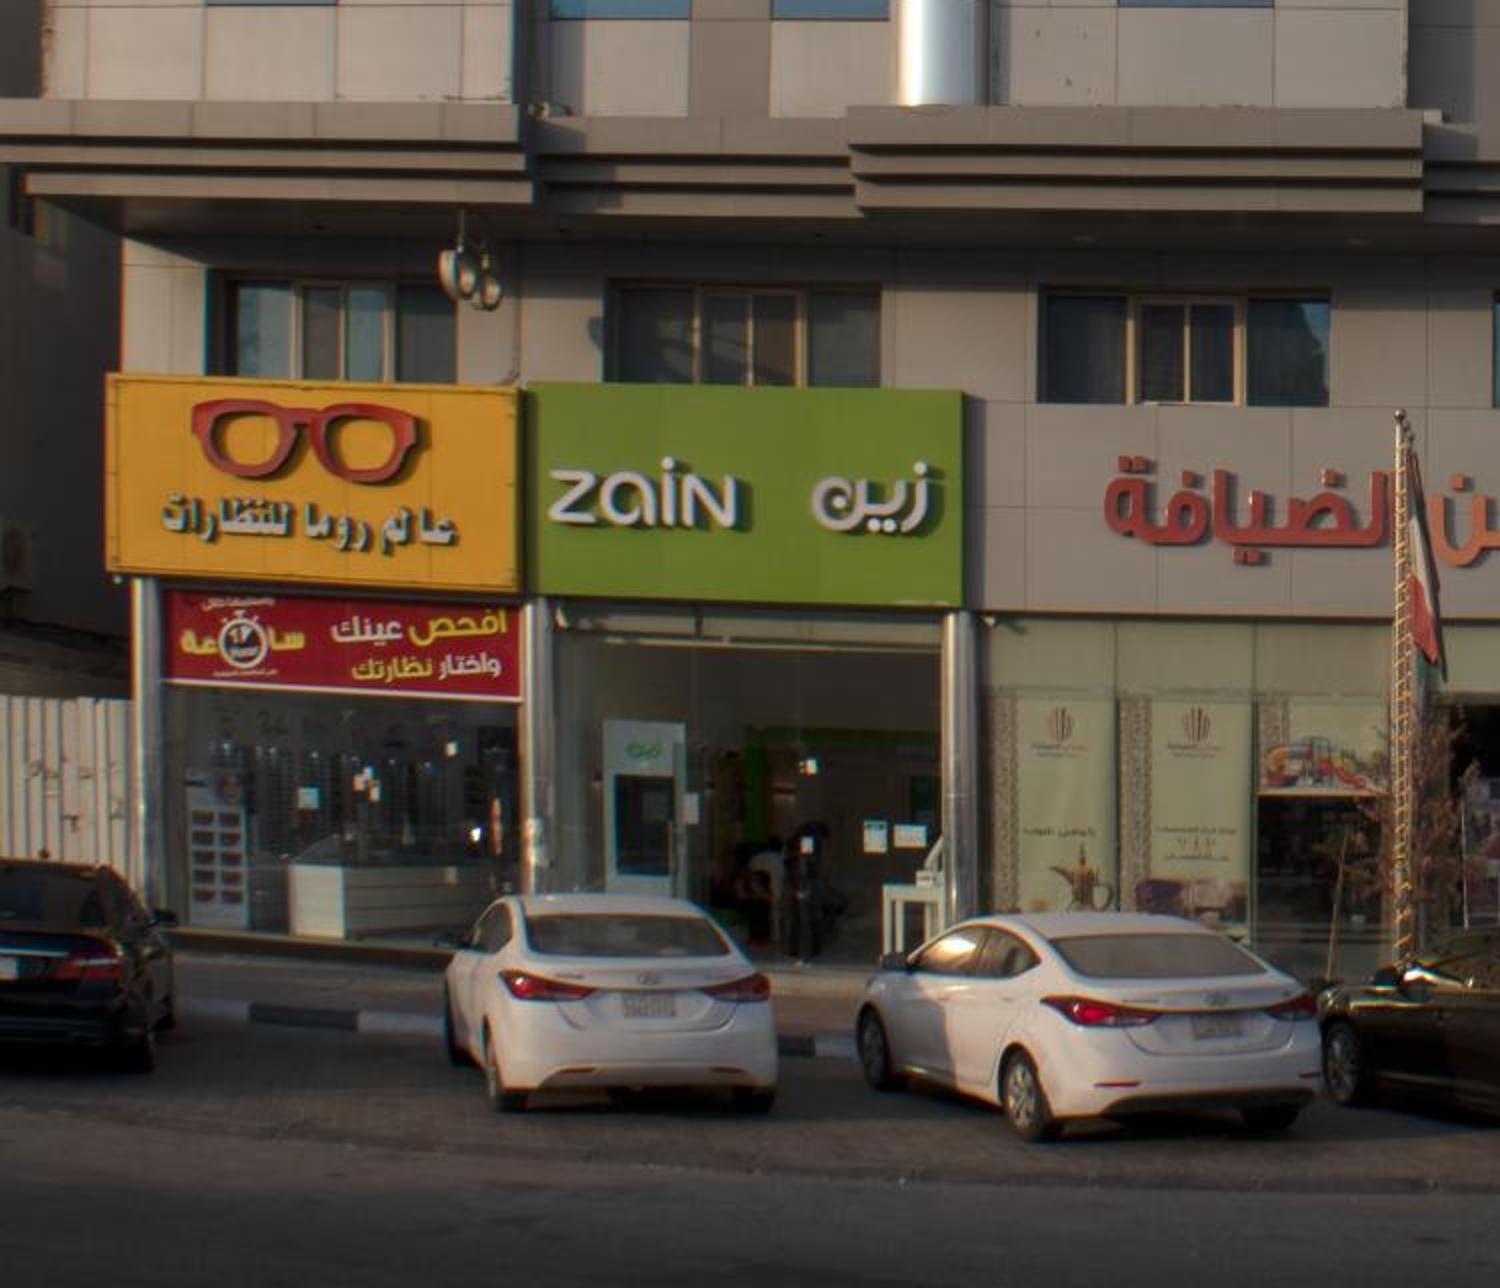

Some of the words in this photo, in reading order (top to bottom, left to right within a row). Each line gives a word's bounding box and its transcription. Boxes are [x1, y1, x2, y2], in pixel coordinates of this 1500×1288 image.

[162, 492, 292, 543] للنظارات
[811, 460, 930, 533] زين
[1103, 455, 1402, 565] الضيافة
[305, 503, 370, 551] روما
[381, 506, 457, 555] عالم
[330, 615, 403, 646] عينك
[407, 609, 507, 646] افحص
[351, 655, 432, 683] نظارتك
[439, 651, 502, 681] واختار
